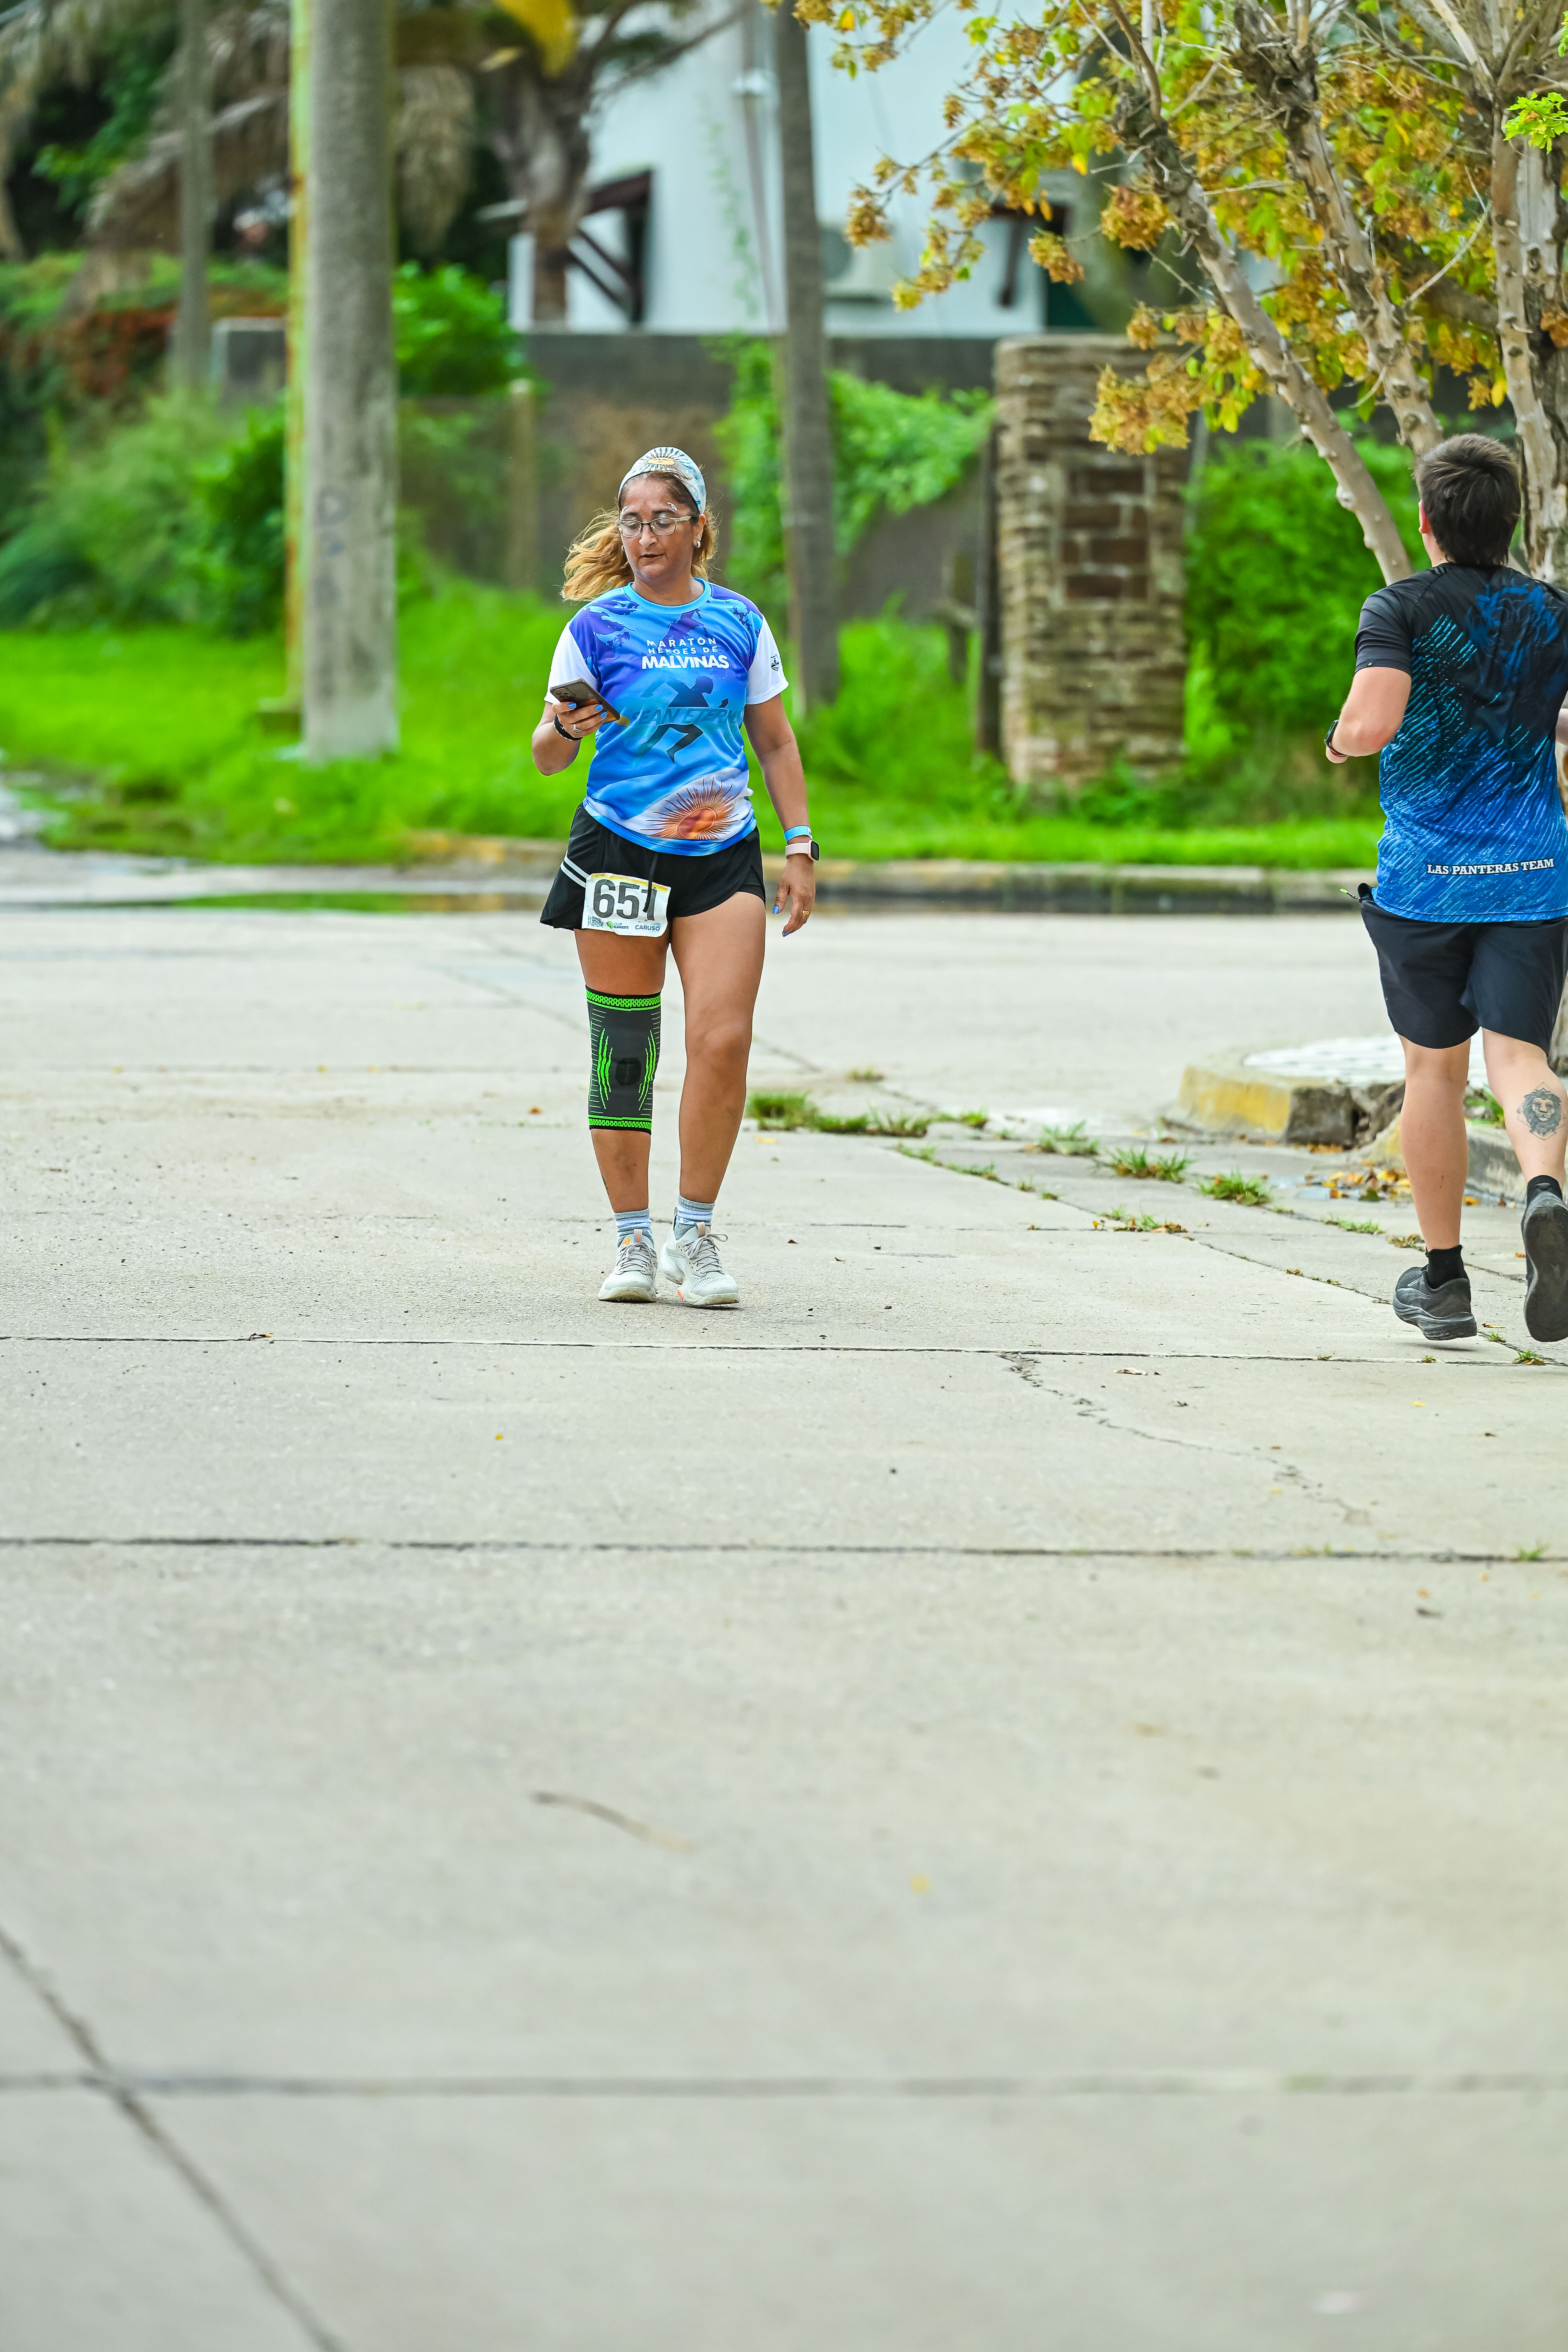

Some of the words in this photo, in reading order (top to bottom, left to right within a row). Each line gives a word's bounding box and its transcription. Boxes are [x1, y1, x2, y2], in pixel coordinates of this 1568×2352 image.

[642, 654, 730, 669] MALVINAS
[1427, 864, 1449, 875] LAS
[1452, 863, 1519, 875] PANTERAS
[1521, 859, 1554, 871] TEAM
